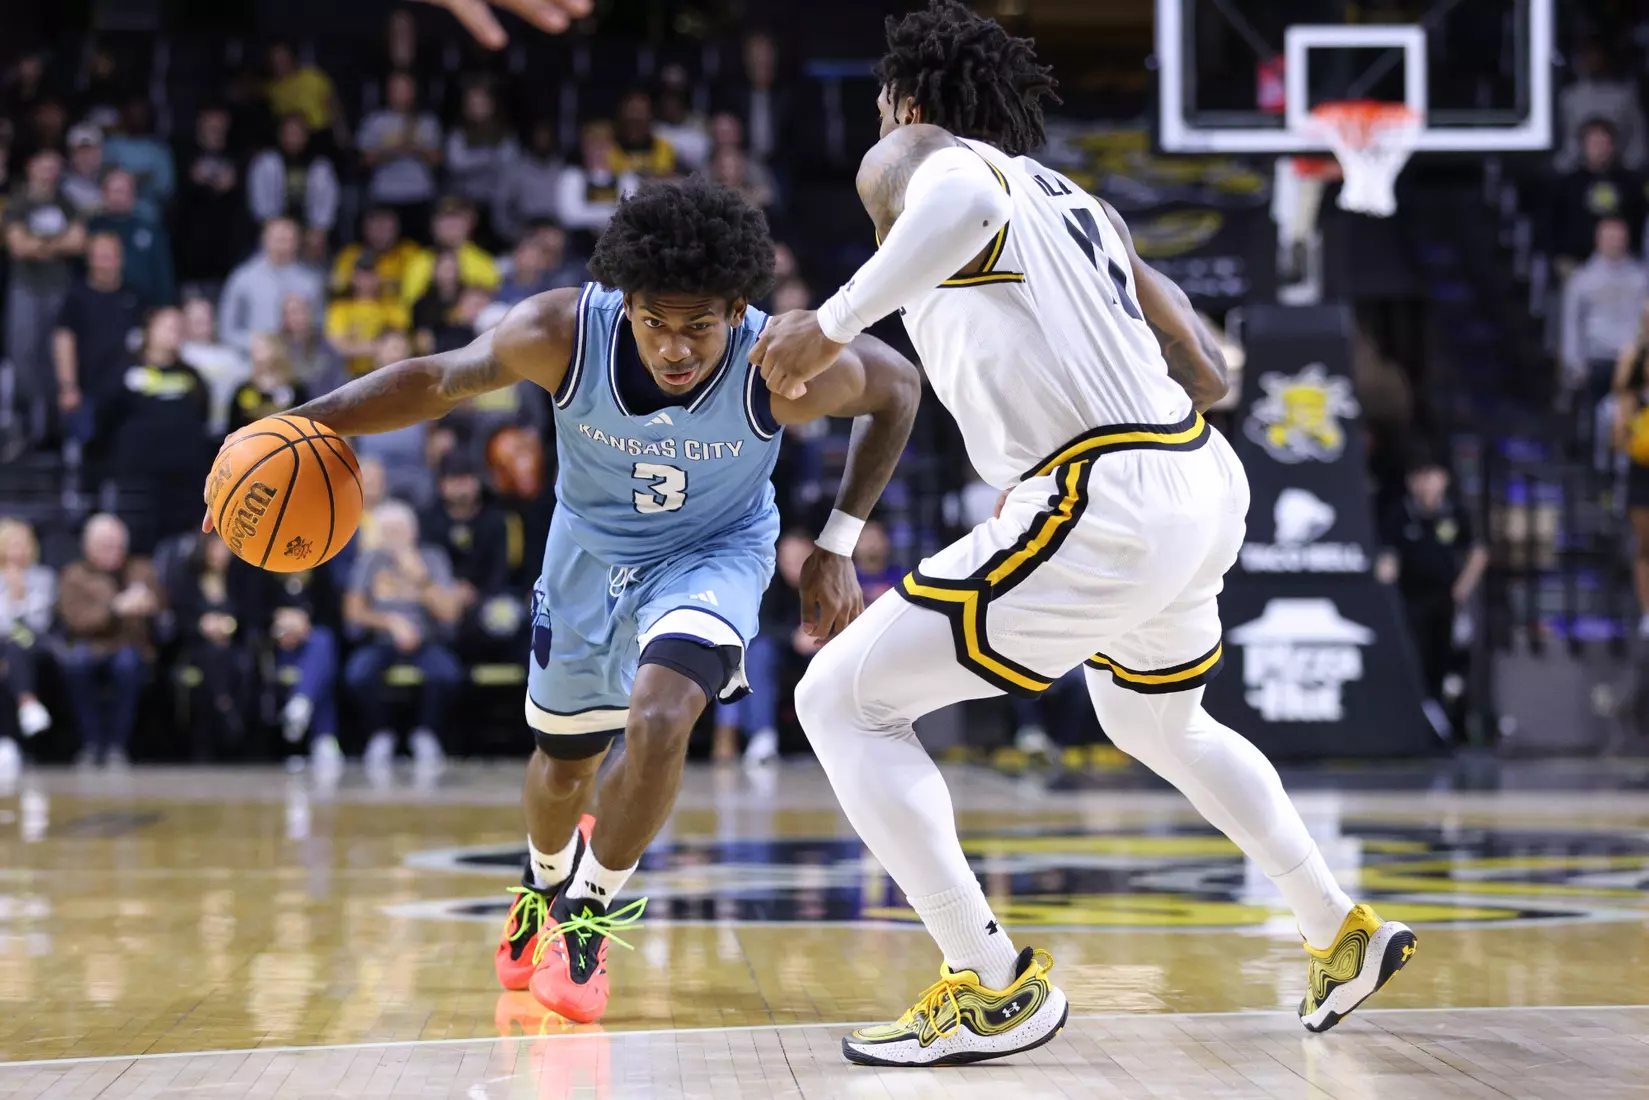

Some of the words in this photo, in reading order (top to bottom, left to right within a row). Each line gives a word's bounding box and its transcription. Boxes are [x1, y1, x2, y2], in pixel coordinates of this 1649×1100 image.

[578, 423, 677, 459] KANSAS
[684, 439, 745, 461] CITY
[631, 462, 689, 514] 3
